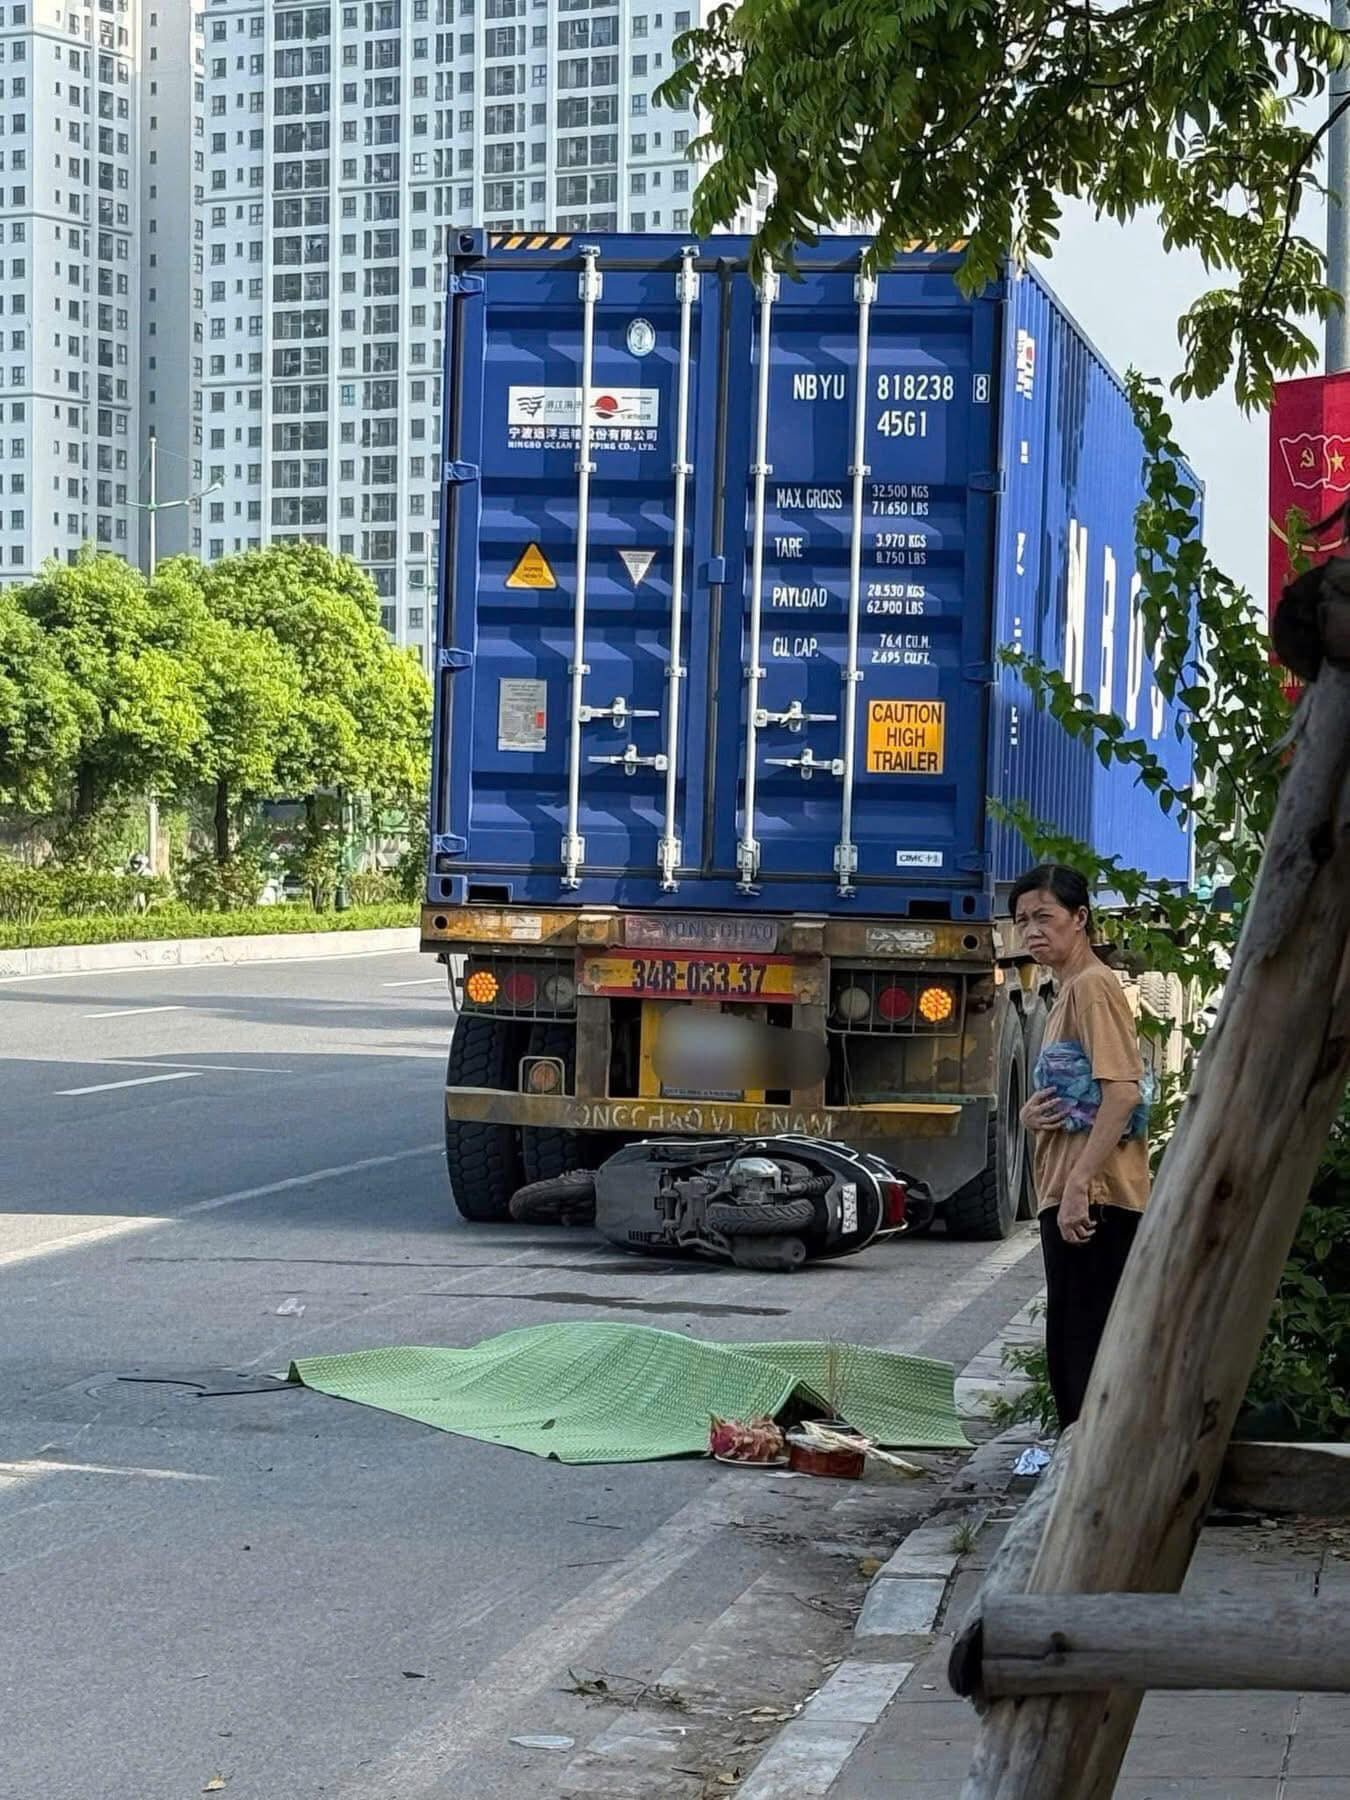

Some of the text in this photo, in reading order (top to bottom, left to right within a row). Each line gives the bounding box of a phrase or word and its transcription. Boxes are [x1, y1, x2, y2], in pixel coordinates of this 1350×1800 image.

[793, 374, 988, 402] NBYU 818238 8
[877, 411, 927, 437] 45G1
[508, 441, 542, 449] NINGBO
[872, 484, 929, 499] 32.500 KGS
[872, 501, 929, 516] 71.650 LBS
[774, 537, 803, 558] TARE
[876, 533, 927, 548] 3.970 KGS
[876, 552, 926, 565] 8.750 LBS
[772, 587, 828, 608] PAYLOAD
[906, 585, 925, 598] KGS
[905, 601, 924, 615] LBS
[794, 637, 819, 658] CAP.
[872, 703, 942, 724] CAUTION
[886, 727, 925, 748] HIGH
[873, 751, 938, 772] TRAILER
[632, 958, 768, 994] 34R-033.37
